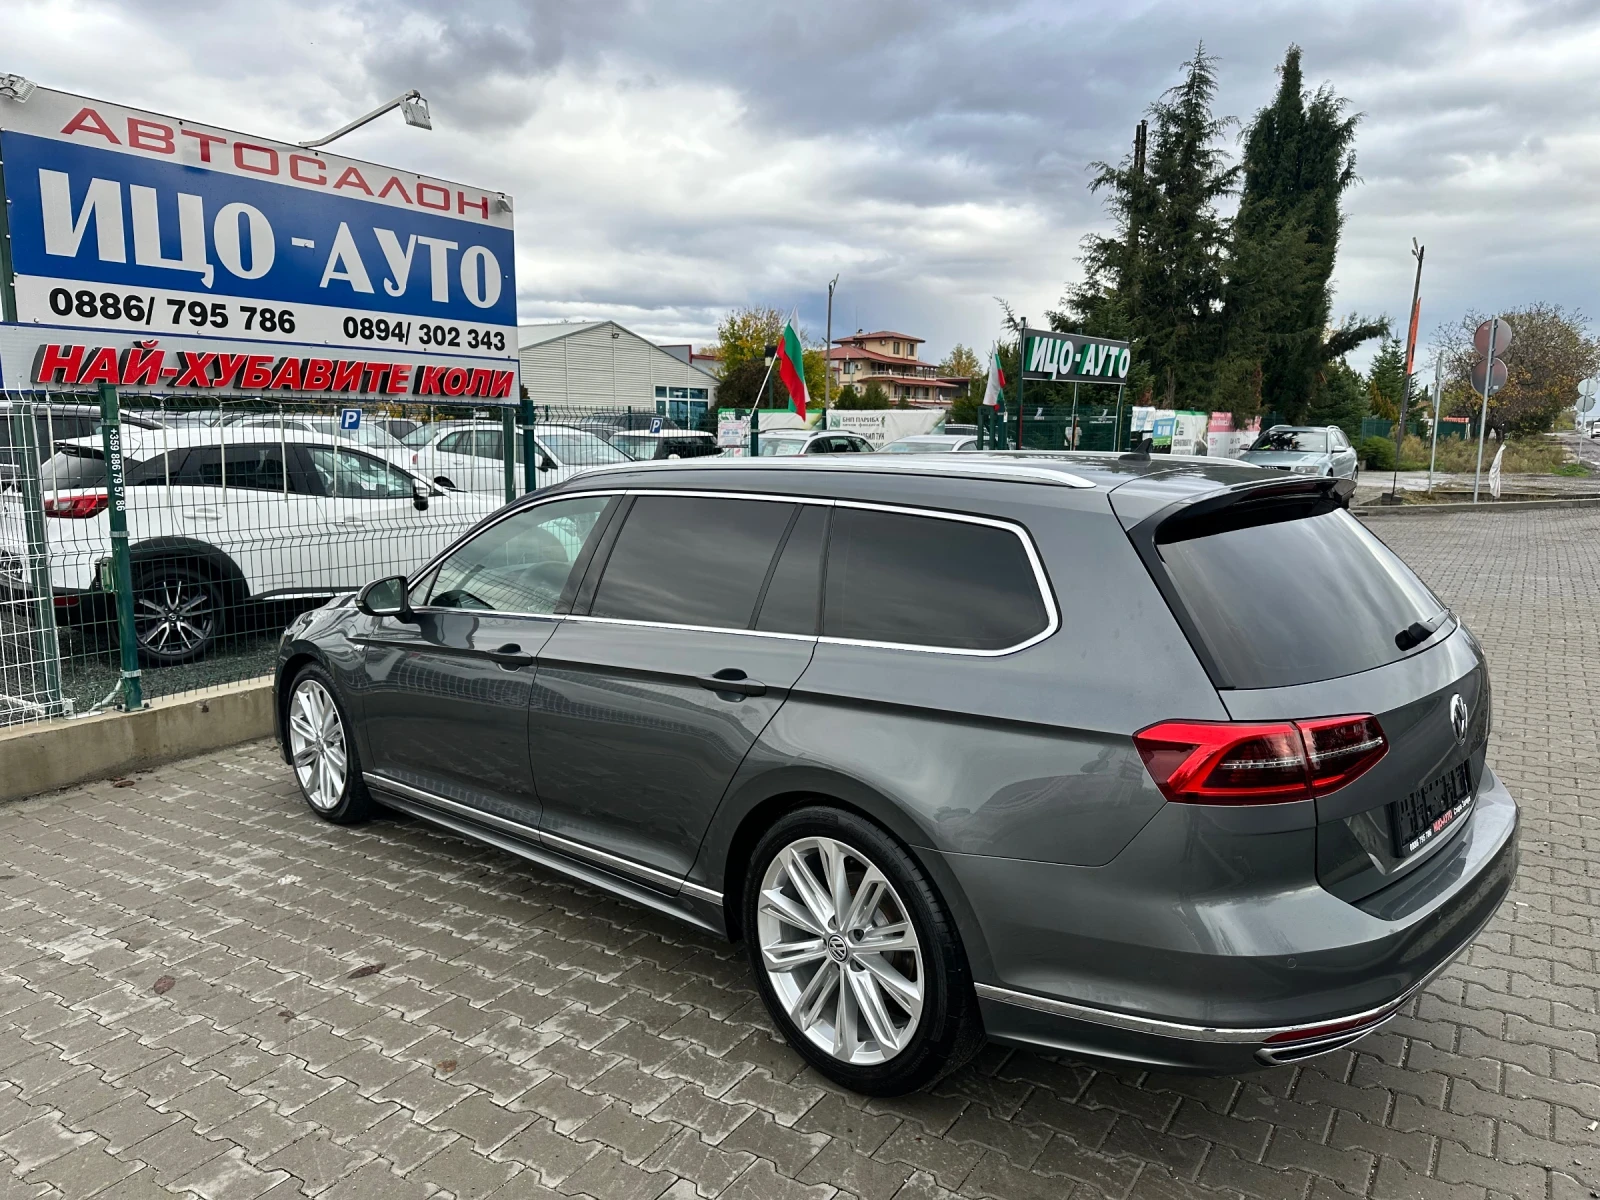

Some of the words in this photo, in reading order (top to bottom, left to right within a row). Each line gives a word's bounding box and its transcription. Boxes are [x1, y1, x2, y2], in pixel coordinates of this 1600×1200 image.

[61, 107, 489, 221] АВТОСАЛОН
[166, 298, 229, 329] 795
[240, 306, 296, 334] 786
[418, 323, 461, 347] 302
[467, 328, 506, 352] 343
[36, 339, 412, 394] НАЙ-ХУБАВИТЕ
[418, 366, 515, 399] КОЛИ
[109, 427, 120, 451] +359
[111, 453, 122, 470] 886
[113, 472, 123, 484] 79
[114, 486, 125, 498] 57
[115, 499, 126, 512] 86
